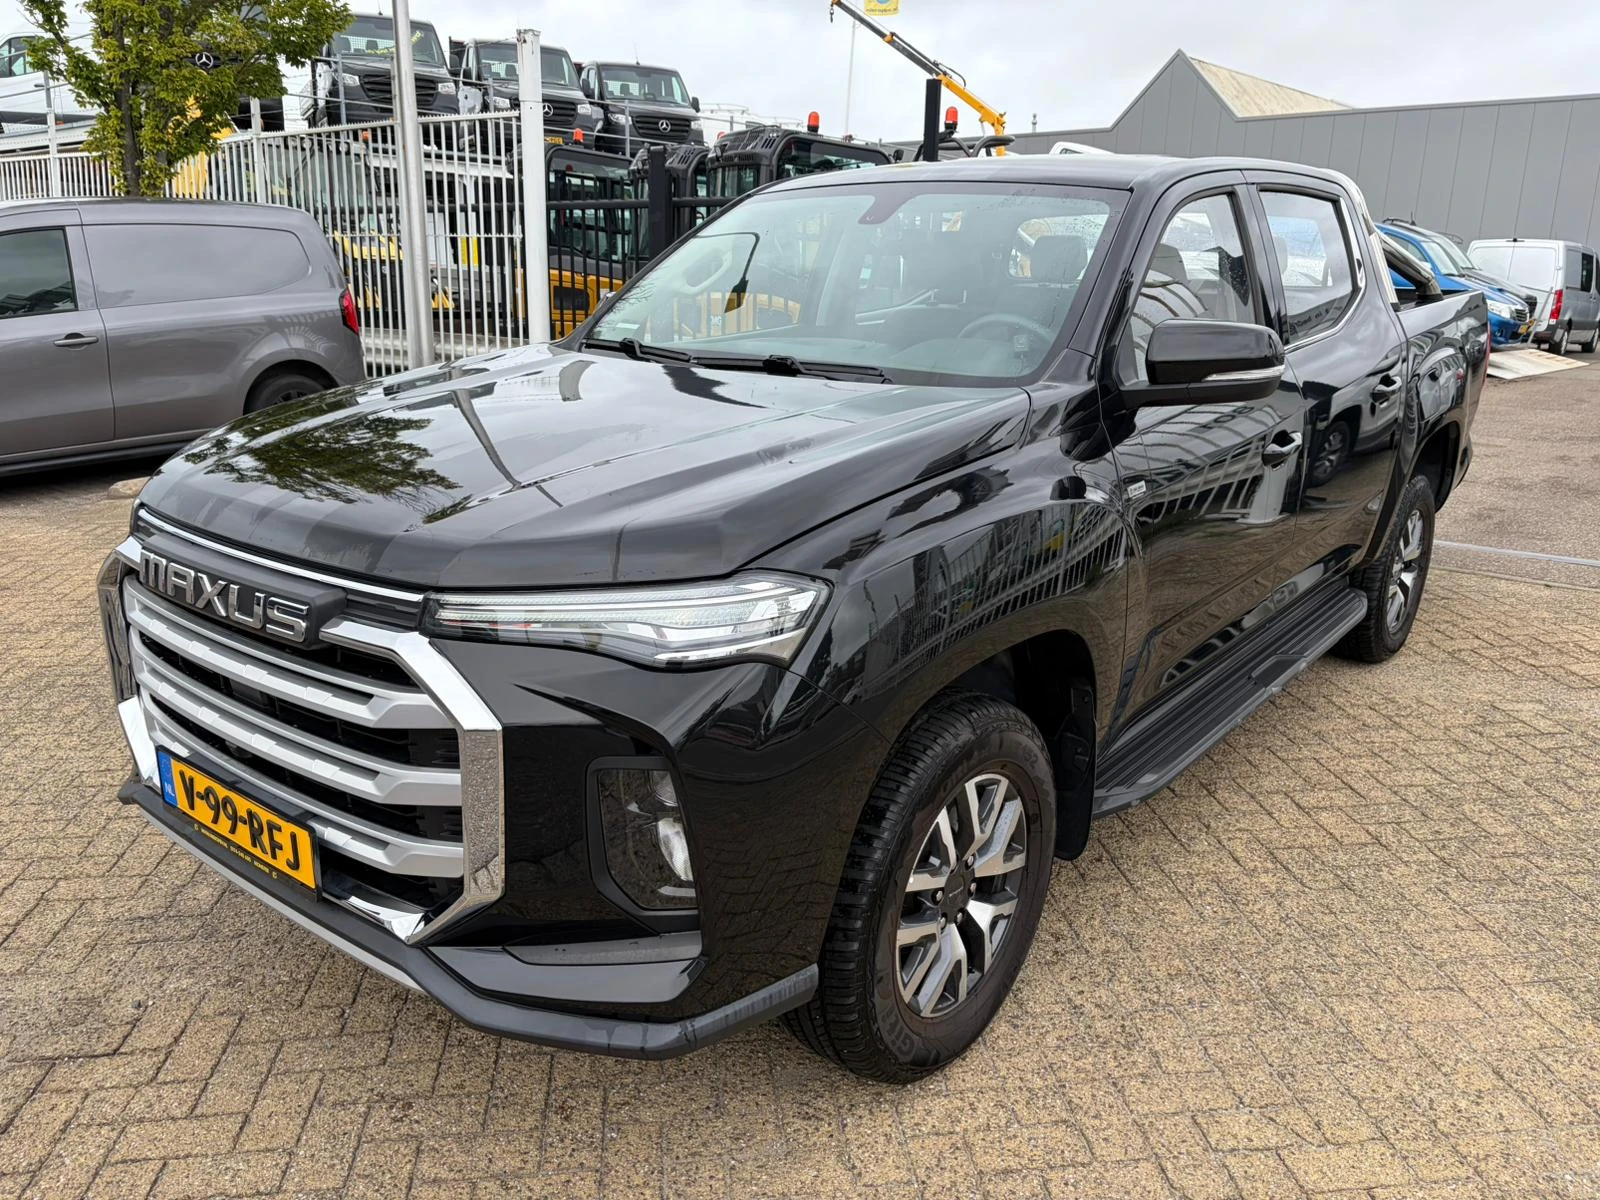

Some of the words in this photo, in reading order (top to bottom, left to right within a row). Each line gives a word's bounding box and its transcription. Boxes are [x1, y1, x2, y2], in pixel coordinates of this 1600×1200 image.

[139, 549, 310, 643] MAXUS
[164, 782, 176, 797] NL
[178, 769, 301, 872] V-99-RFJ
